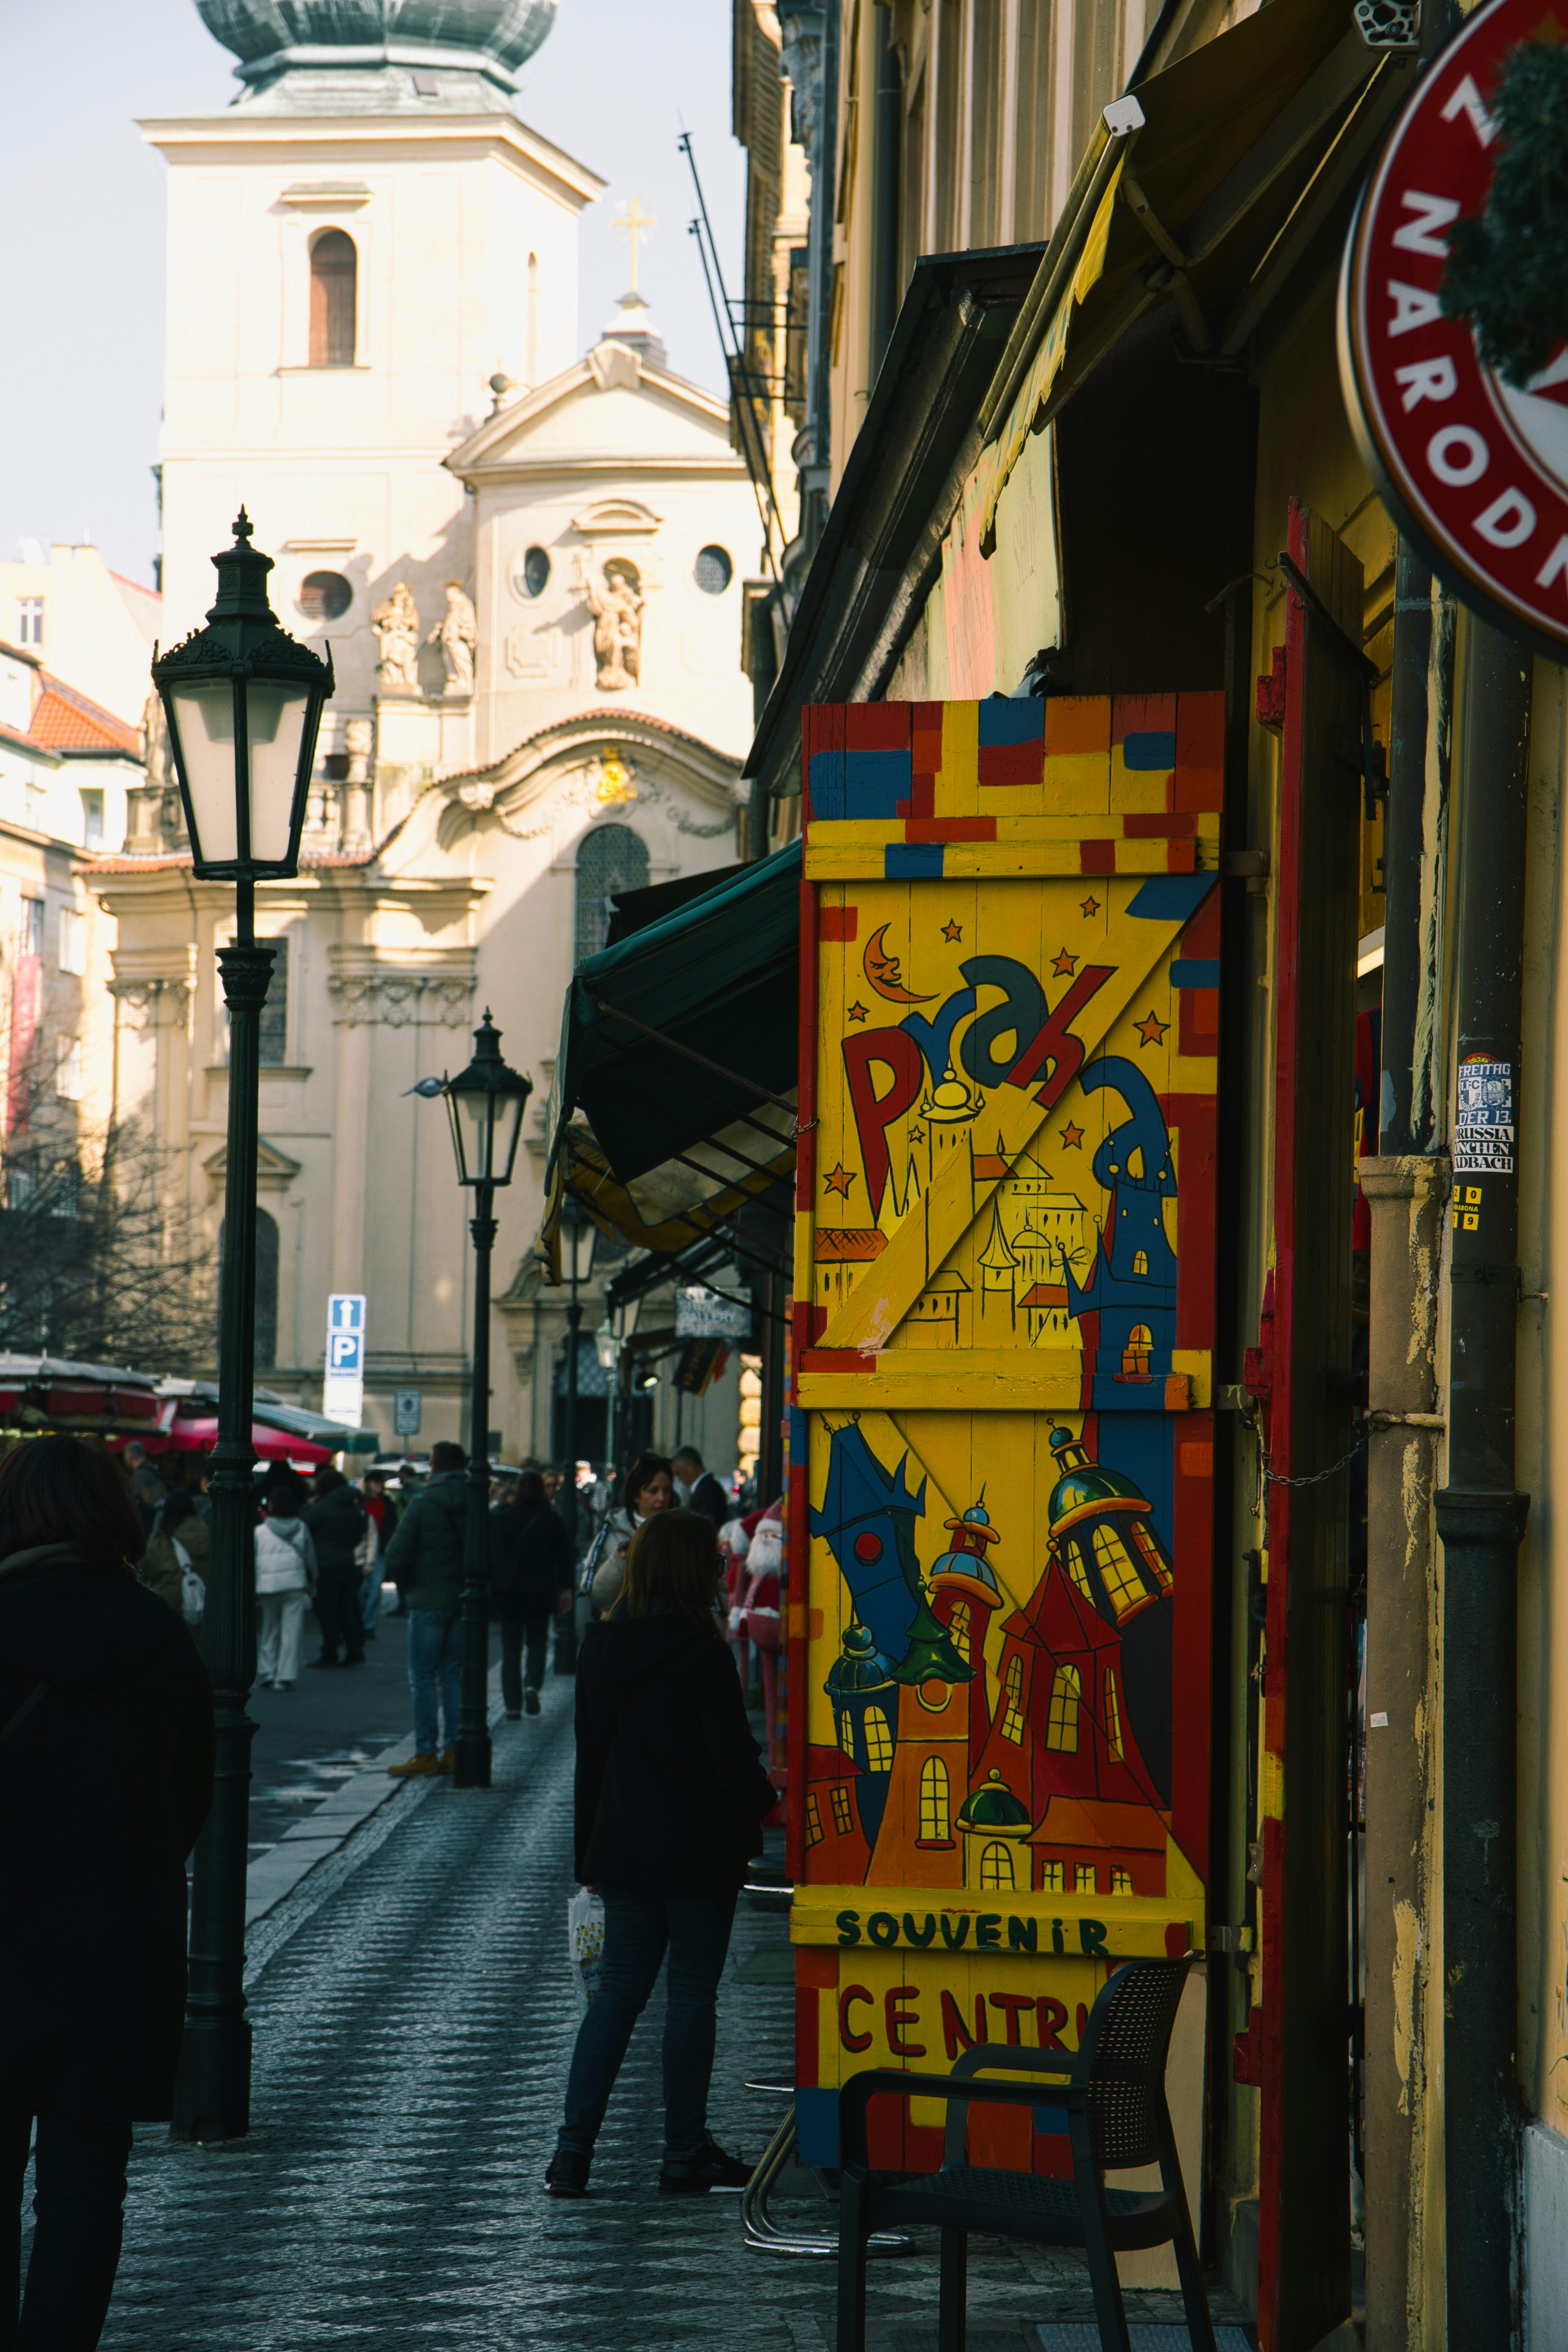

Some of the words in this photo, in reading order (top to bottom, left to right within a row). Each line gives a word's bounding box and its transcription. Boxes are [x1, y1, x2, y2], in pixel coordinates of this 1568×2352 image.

[1459, 1063, 1511, 1077] FREITAG
[841, 954, 1178, 1221] Praha
[1460, 1093, 1481, 1110] MAGDEBURG
[1459, 1111, 1489, 1127] DER
[1495, 1111, 1512, 1123] 13.
[679, 1311, 736, 1323] GALLERY
[333, 1336, 356, 1367] P
